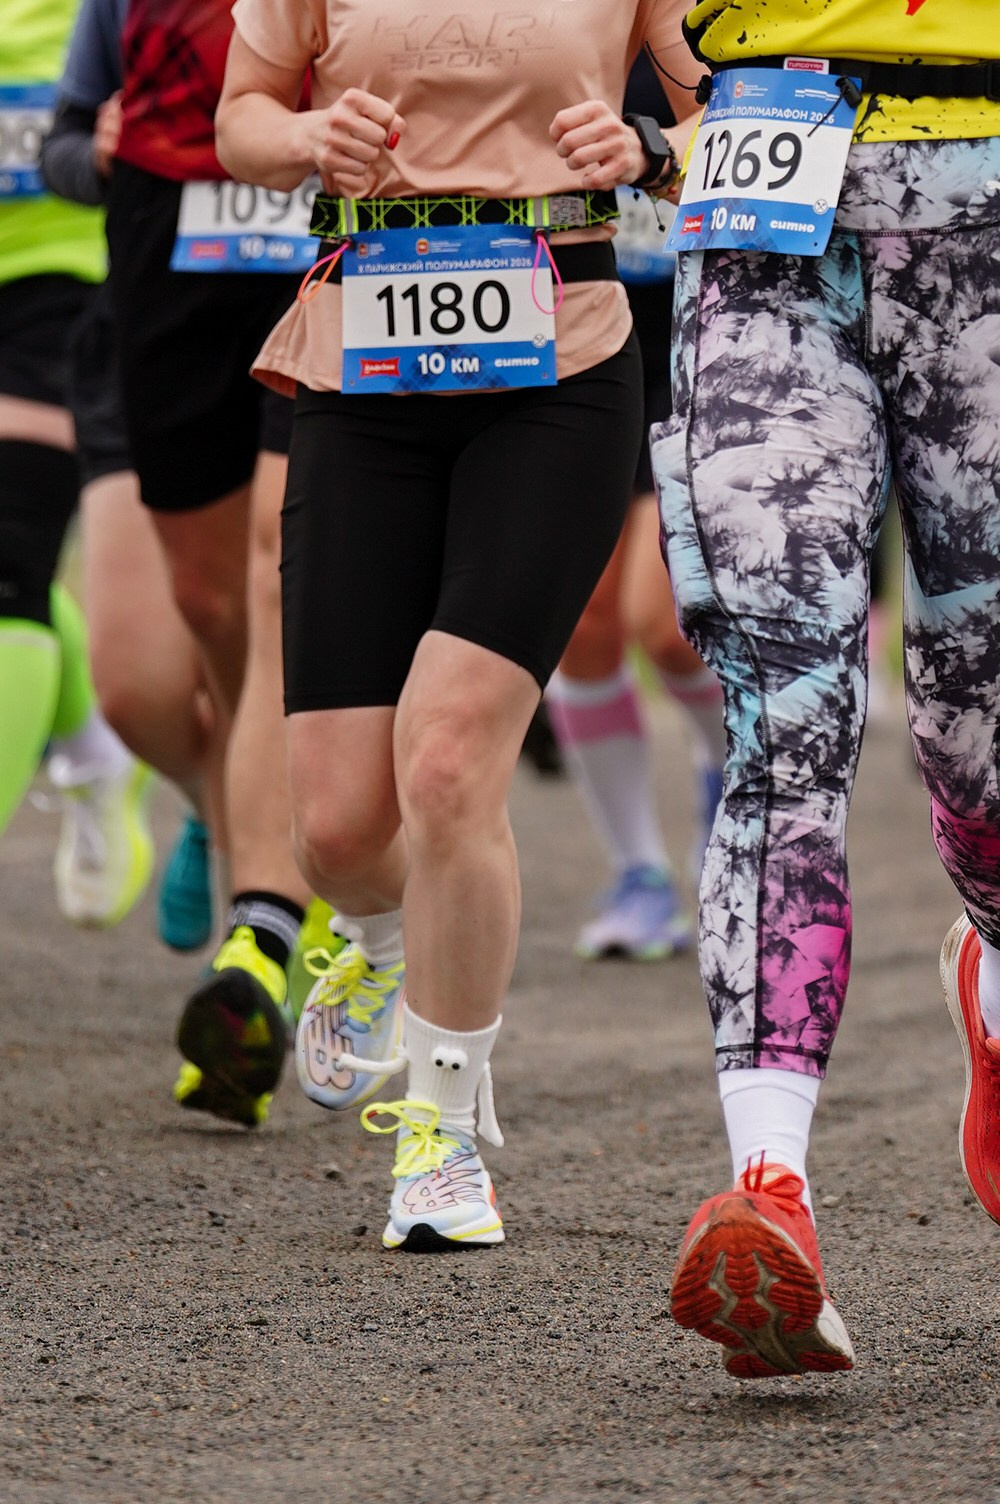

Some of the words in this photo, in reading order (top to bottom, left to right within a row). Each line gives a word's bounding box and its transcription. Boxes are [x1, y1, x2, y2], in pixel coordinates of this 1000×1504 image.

[736, 106, 808, 120] ПОЛУМАРАФОН
[702, 129, 803, 191] 1269
[711, 206, 728, 231] 10
[365, 260, 424, 274] ПАРИЖСКИЙ
[425, 257, 509, 271] ПОЛУМАРАФОН
[376, 279, 511, 337] 1180
[417, 352, 446, 376] 10
